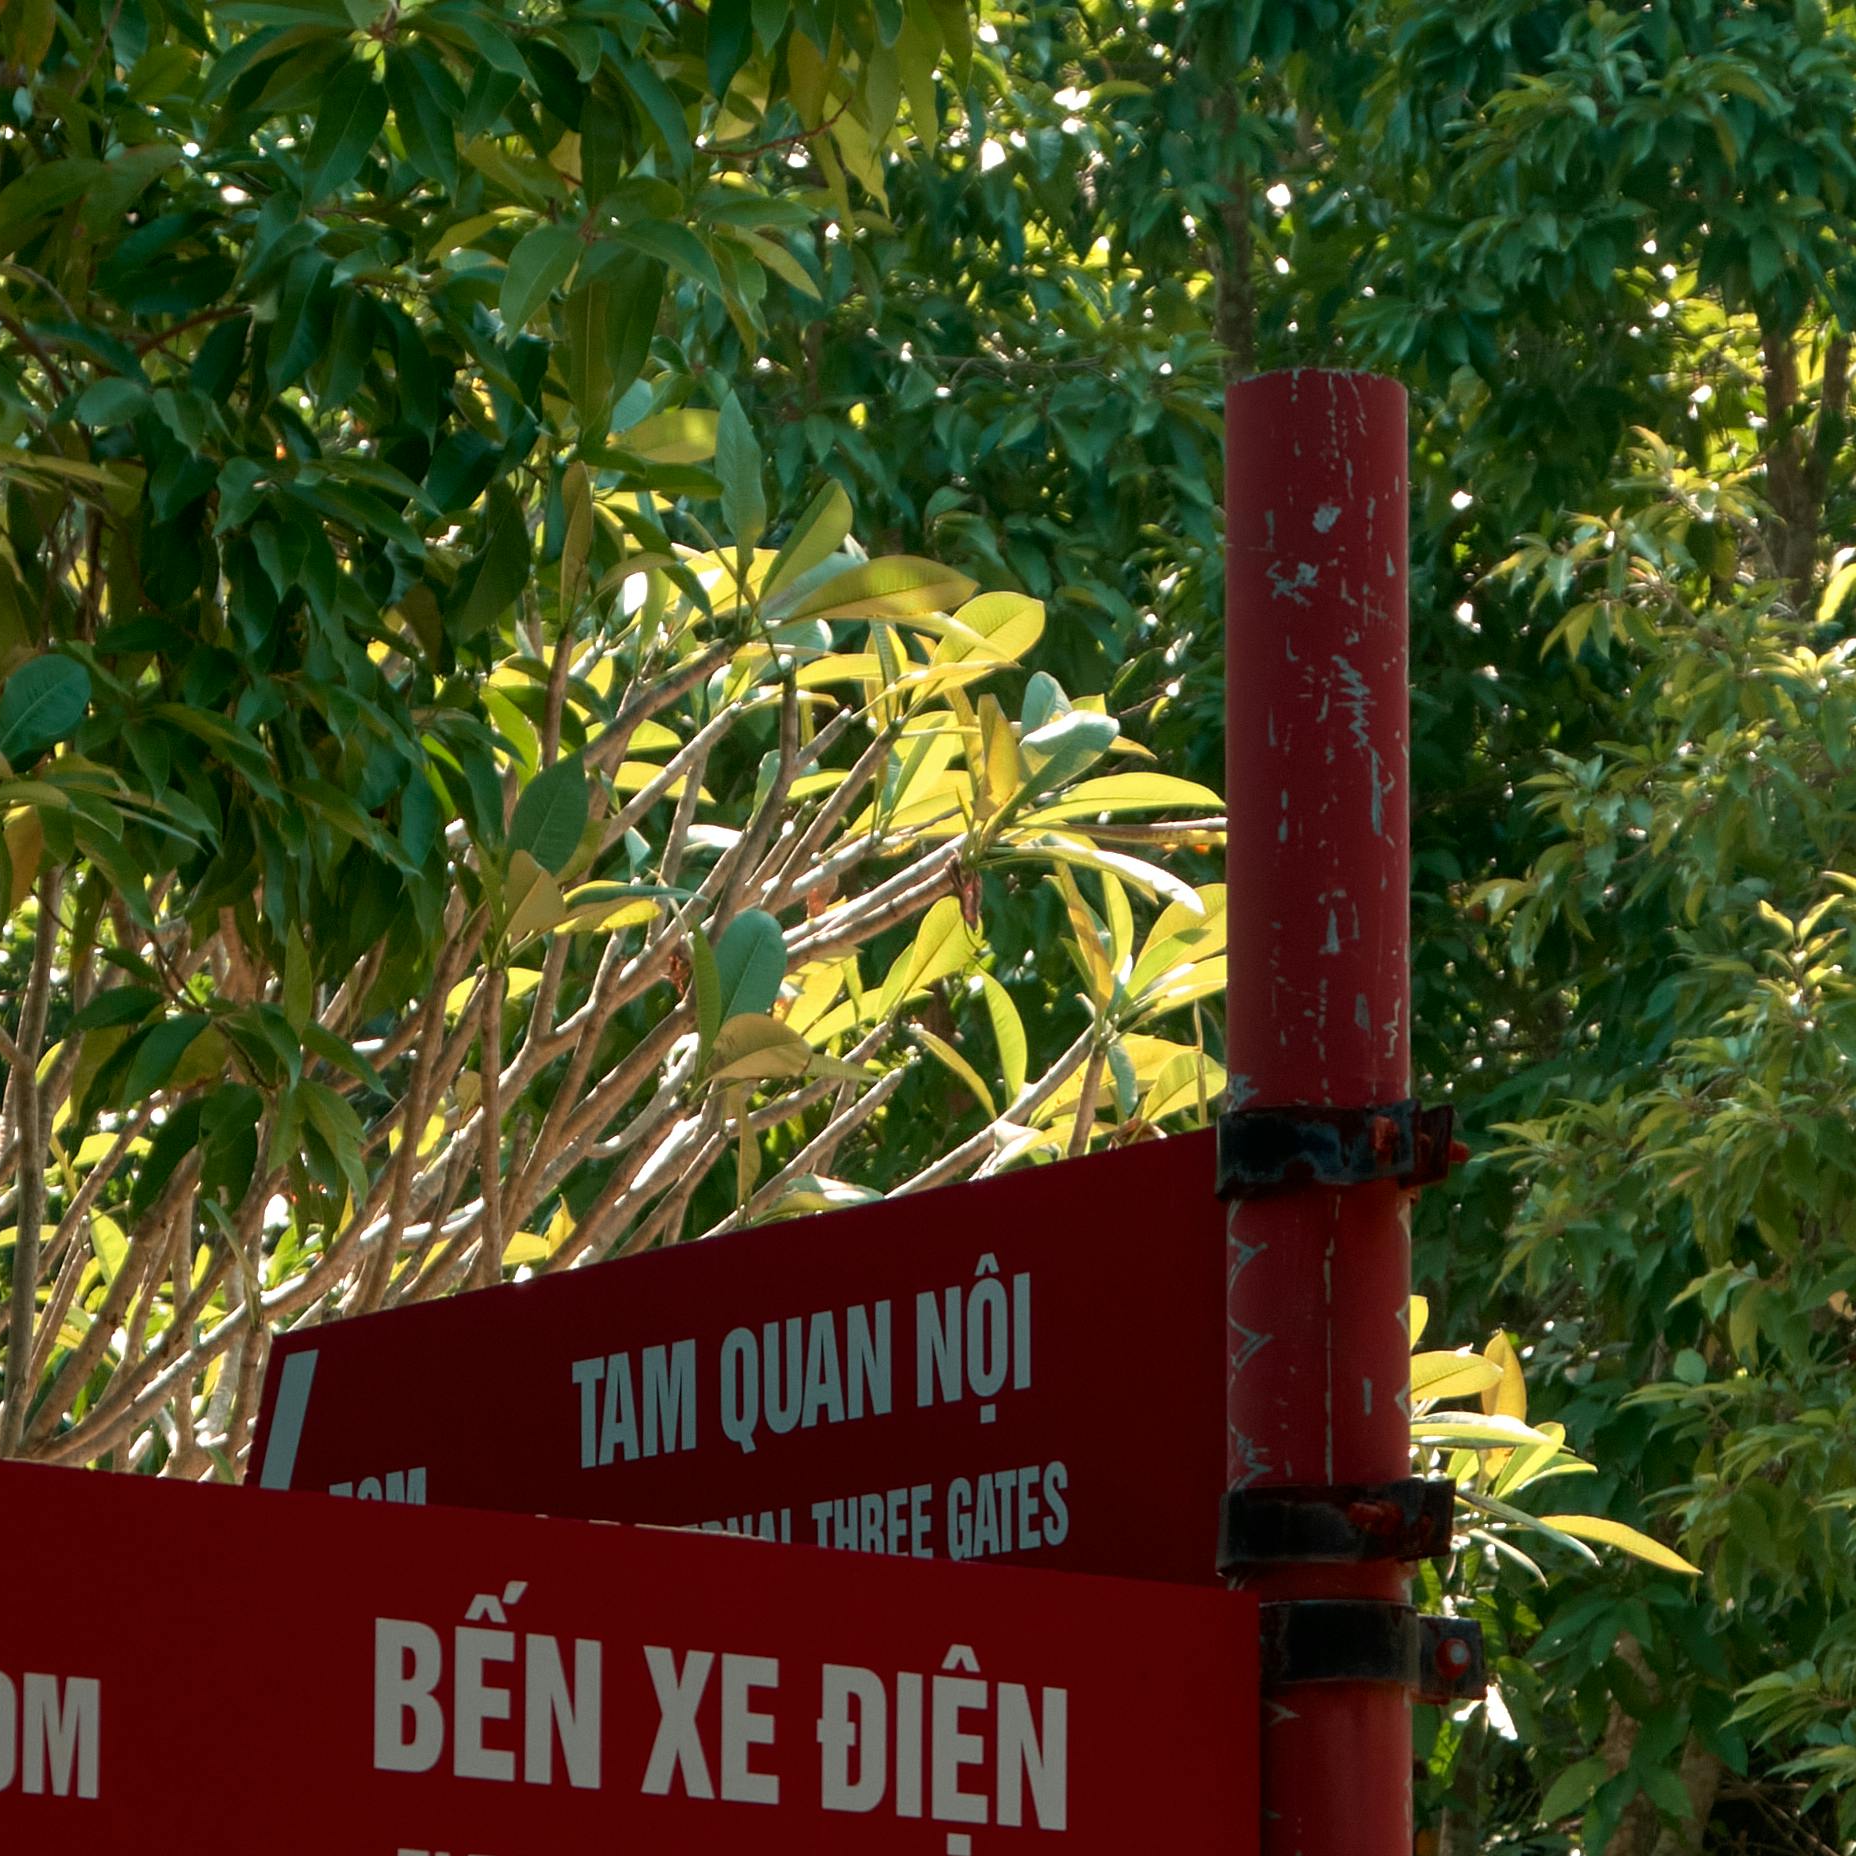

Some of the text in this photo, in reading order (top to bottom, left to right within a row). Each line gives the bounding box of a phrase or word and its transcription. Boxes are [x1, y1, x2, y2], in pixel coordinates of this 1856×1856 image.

[571, 1252, 1032, 1469] TAM QUAN NỘI
[811, 1483, 934, 1560] THREE
[947, 1460, 1069, 1562] GATES
[373, 1580, 602, 1790] BẾN
[641, 1645, 780, 1805] XE
